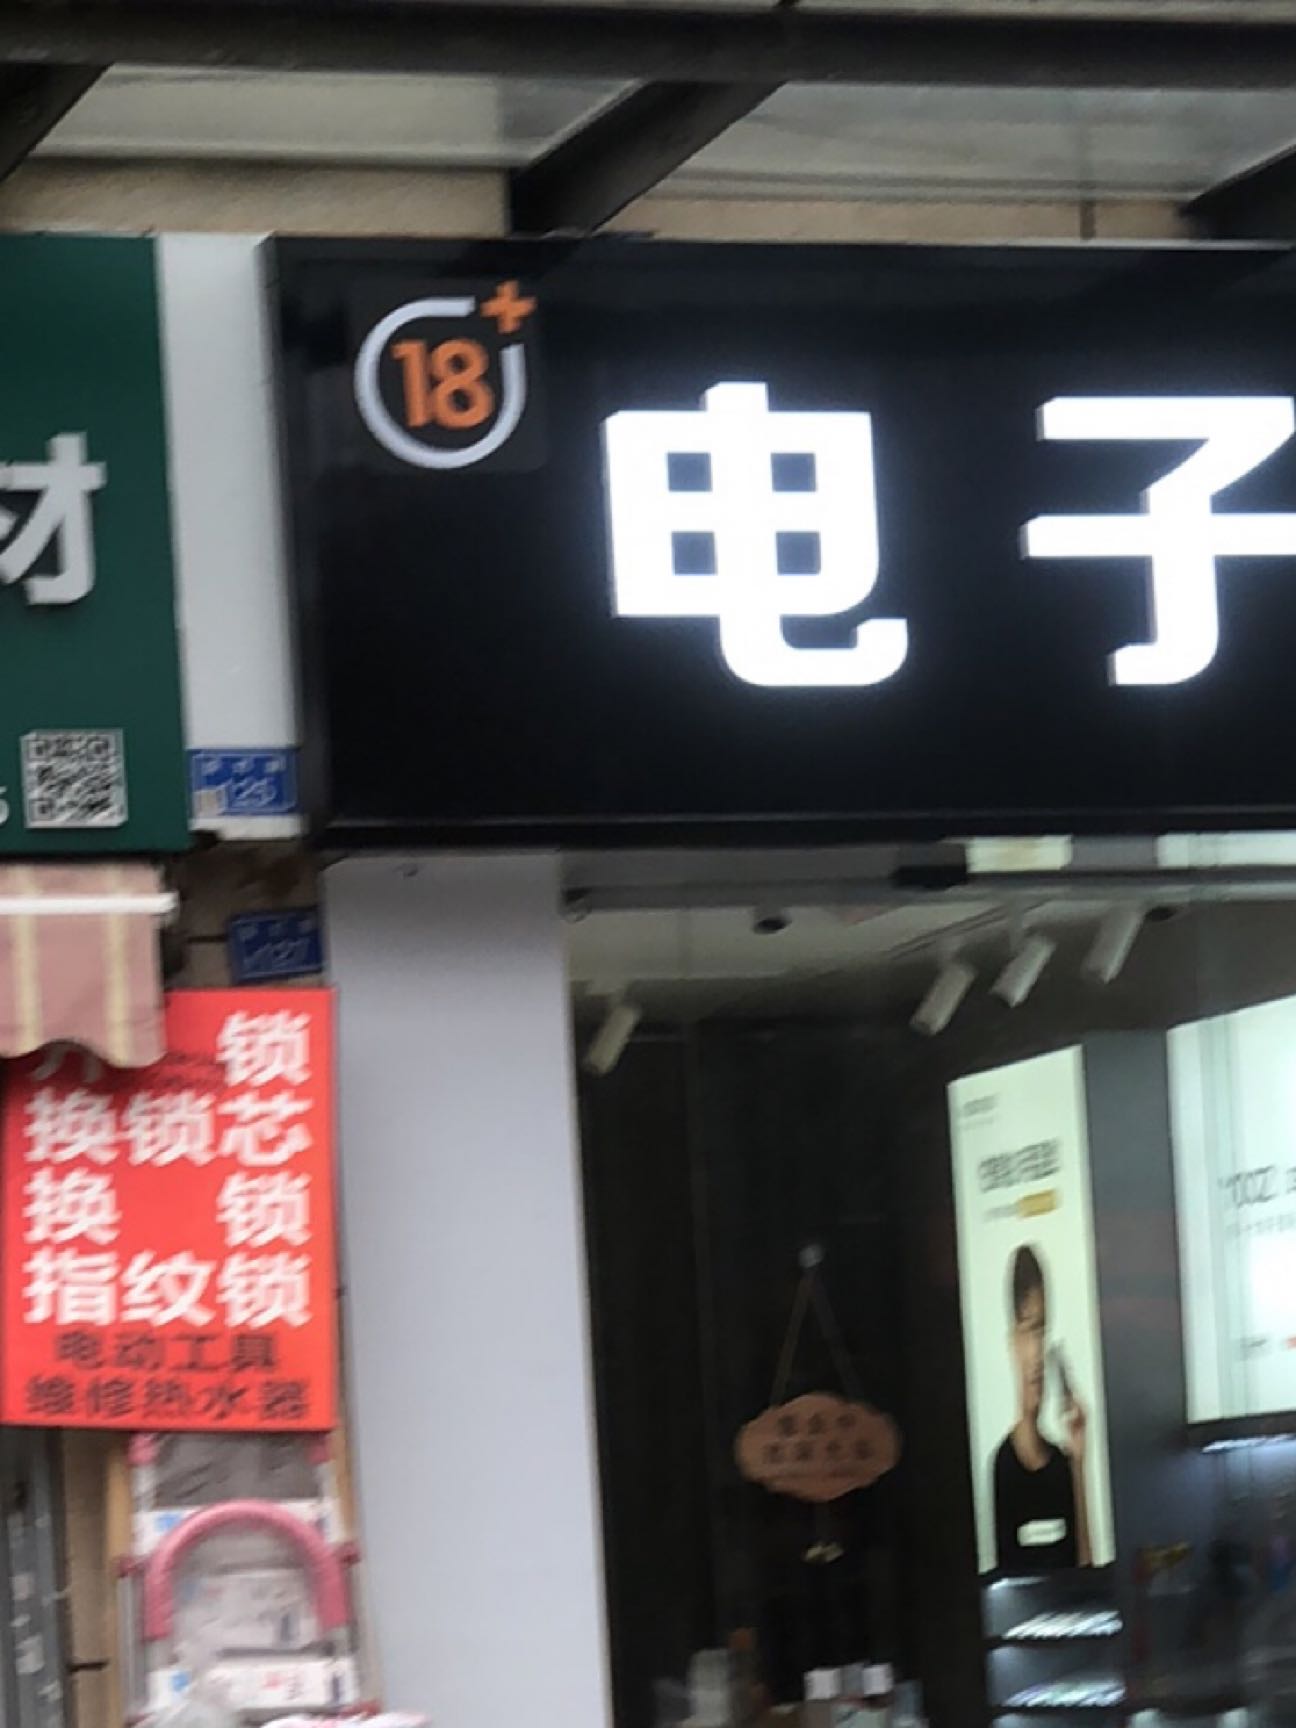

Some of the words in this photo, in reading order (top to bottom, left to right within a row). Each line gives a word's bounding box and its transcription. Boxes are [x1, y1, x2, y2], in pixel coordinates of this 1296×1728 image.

[22, 1087, 314, 1167] 换锁芯
[20, 1248, 314, 1329] 指纹锁
